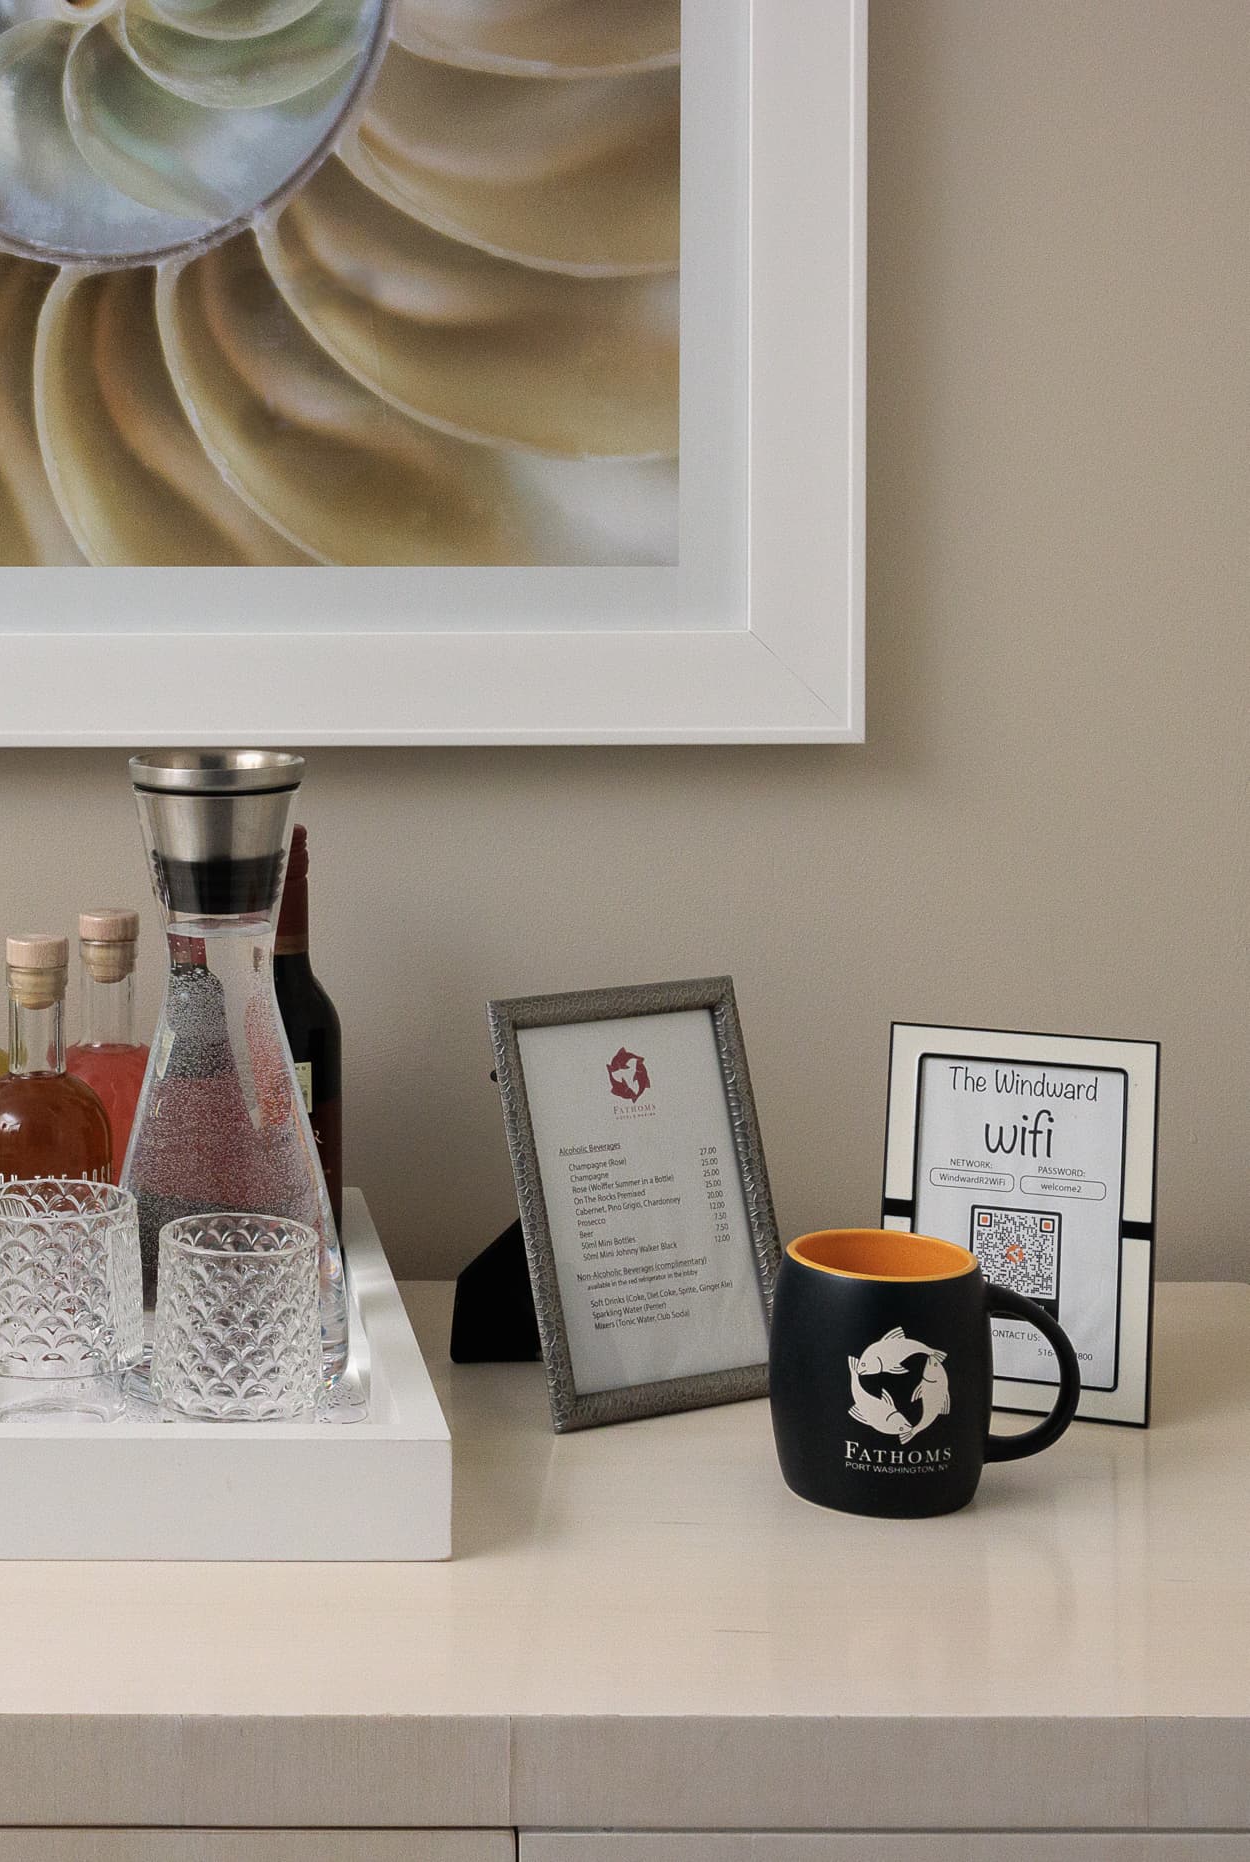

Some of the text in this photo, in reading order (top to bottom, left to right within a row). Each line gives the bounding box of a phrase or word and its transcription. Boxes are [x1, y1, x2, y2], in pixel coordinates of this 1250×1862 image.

[949, 1066, 1098, 1102] The Windward
[984, 1109, 1055, 1158] wifi
[559, 1142, 621, 1156] Alcoholic Beverages
[569, 1160, 607, 1171] Champagne
[950, 1158, 993, 1169] NETWORK:
[570, 1157, 718, 1182] Champagne 25.00
[1038, 1166, 1086, 1177] PASSWORD:
[615, 1179, 640, 1188] Summer
[703, 1168, 720, 1177] 25.00
[939, 1172, 1006, 1187] WindwardR2WiFi
[1041, 1182, 1082, 1193] welcome2
[597, 1193, 616, 1202] Rocks
[577, 1218, 606, 1227] Prosecco
[605, 1296, 625, 1306] Drinks
[592, 1308, 622, 1320] Sparkling
[623, 1305, 642, 1315] Water
[991, 1329, 1025, 1340] ONTACT
[844, 1440, 951, 1464] FATHOMS
[845, 1461, 871, 1472] PORT
